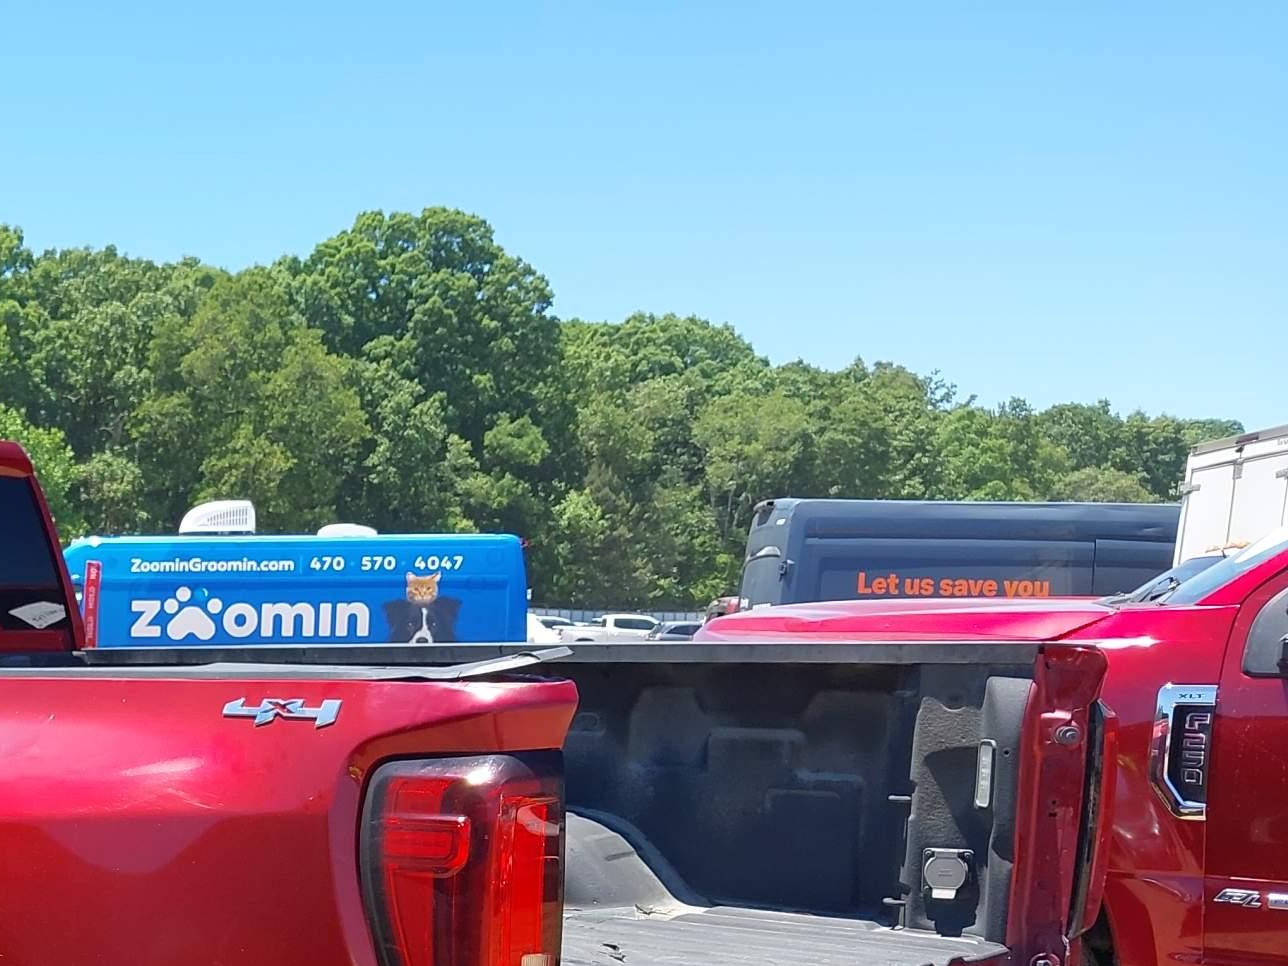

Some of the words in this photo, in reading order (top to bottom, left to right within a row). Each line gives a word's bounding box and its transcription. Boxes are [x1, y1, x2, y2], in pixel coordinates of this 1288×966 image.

[130, 557, 295, 573] ZoominGroomin.com
[310, 556, 345, 571] 470
[361, 555, 396, 571] 570
[414, 555, 464, 571] 4047
[857, 572, 899, 595] Let
[904, 578, 934, 596] us
[939, 579, 997, 597] save
[1003, 580, 1050, 599] you
